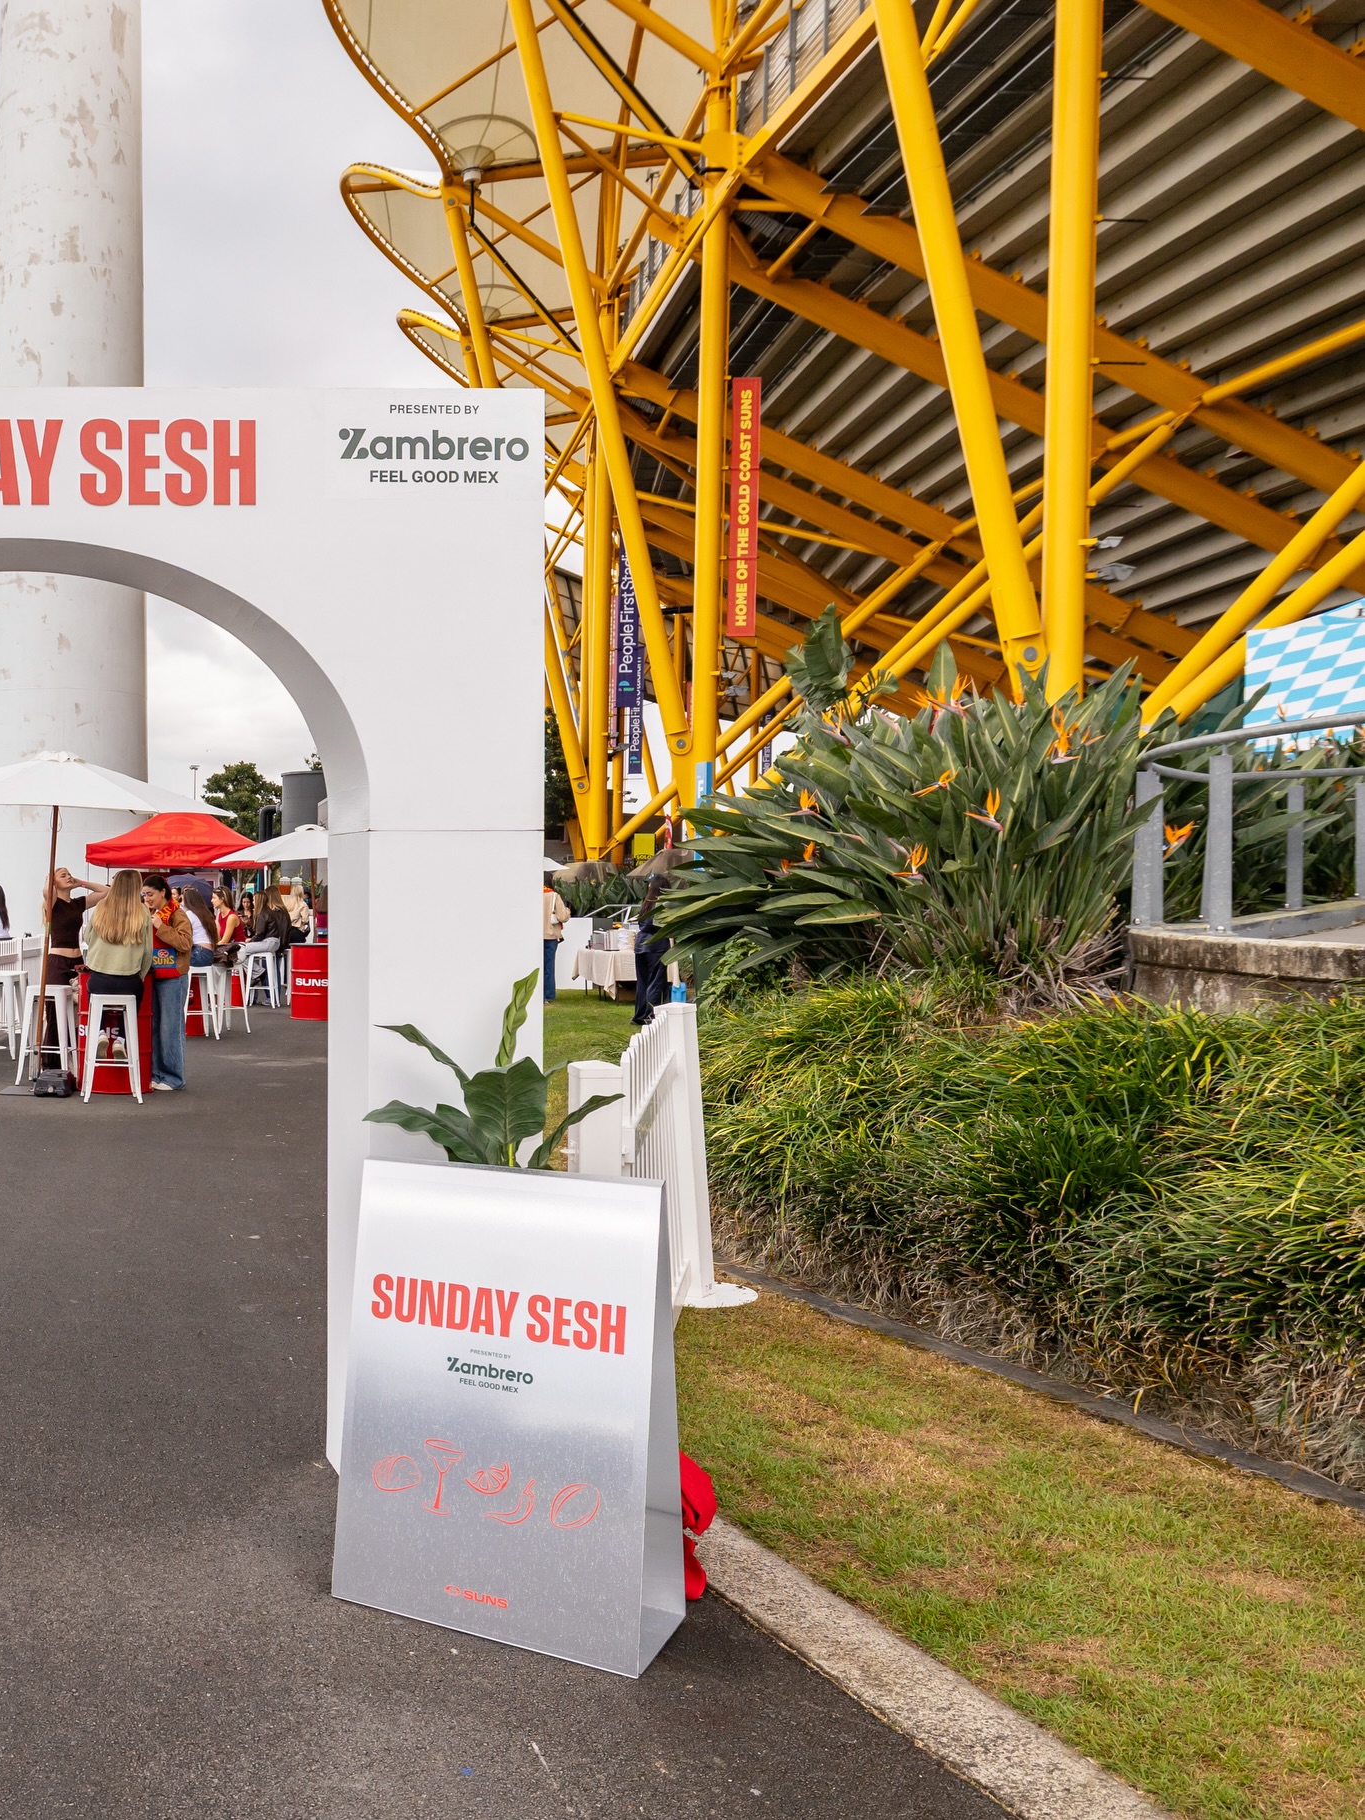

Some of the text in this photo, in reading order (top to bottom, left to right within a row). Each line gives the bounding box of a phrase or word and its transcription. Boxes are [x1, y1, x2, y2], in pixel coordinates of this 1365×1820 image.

[389, 404, 479, 415] PRESENTED BY
[338, 428, 530, 462] Zambrero
[79, 418, 257, 507] SESH
[370, 470, 499, 484] FEEL GOOD MEX
[735, 389, 753, 627] HOME OF THE GOLD COAST SUNS
[152, 849, 199, 861] SUNS
[152, 955, 175, 965] SUNS
[295, 977, 329, 987] SUNS
[371, 1273, 627, 1355] SUNDAY SESH
[469, 1348, 503, 1359] PRESENTED
[446, 1356, 534, 1385] Zambrero
[459, 1377, 519, 1394] FEEL GOOD MEX
[463, 1588, 508, 1609] SUNS
